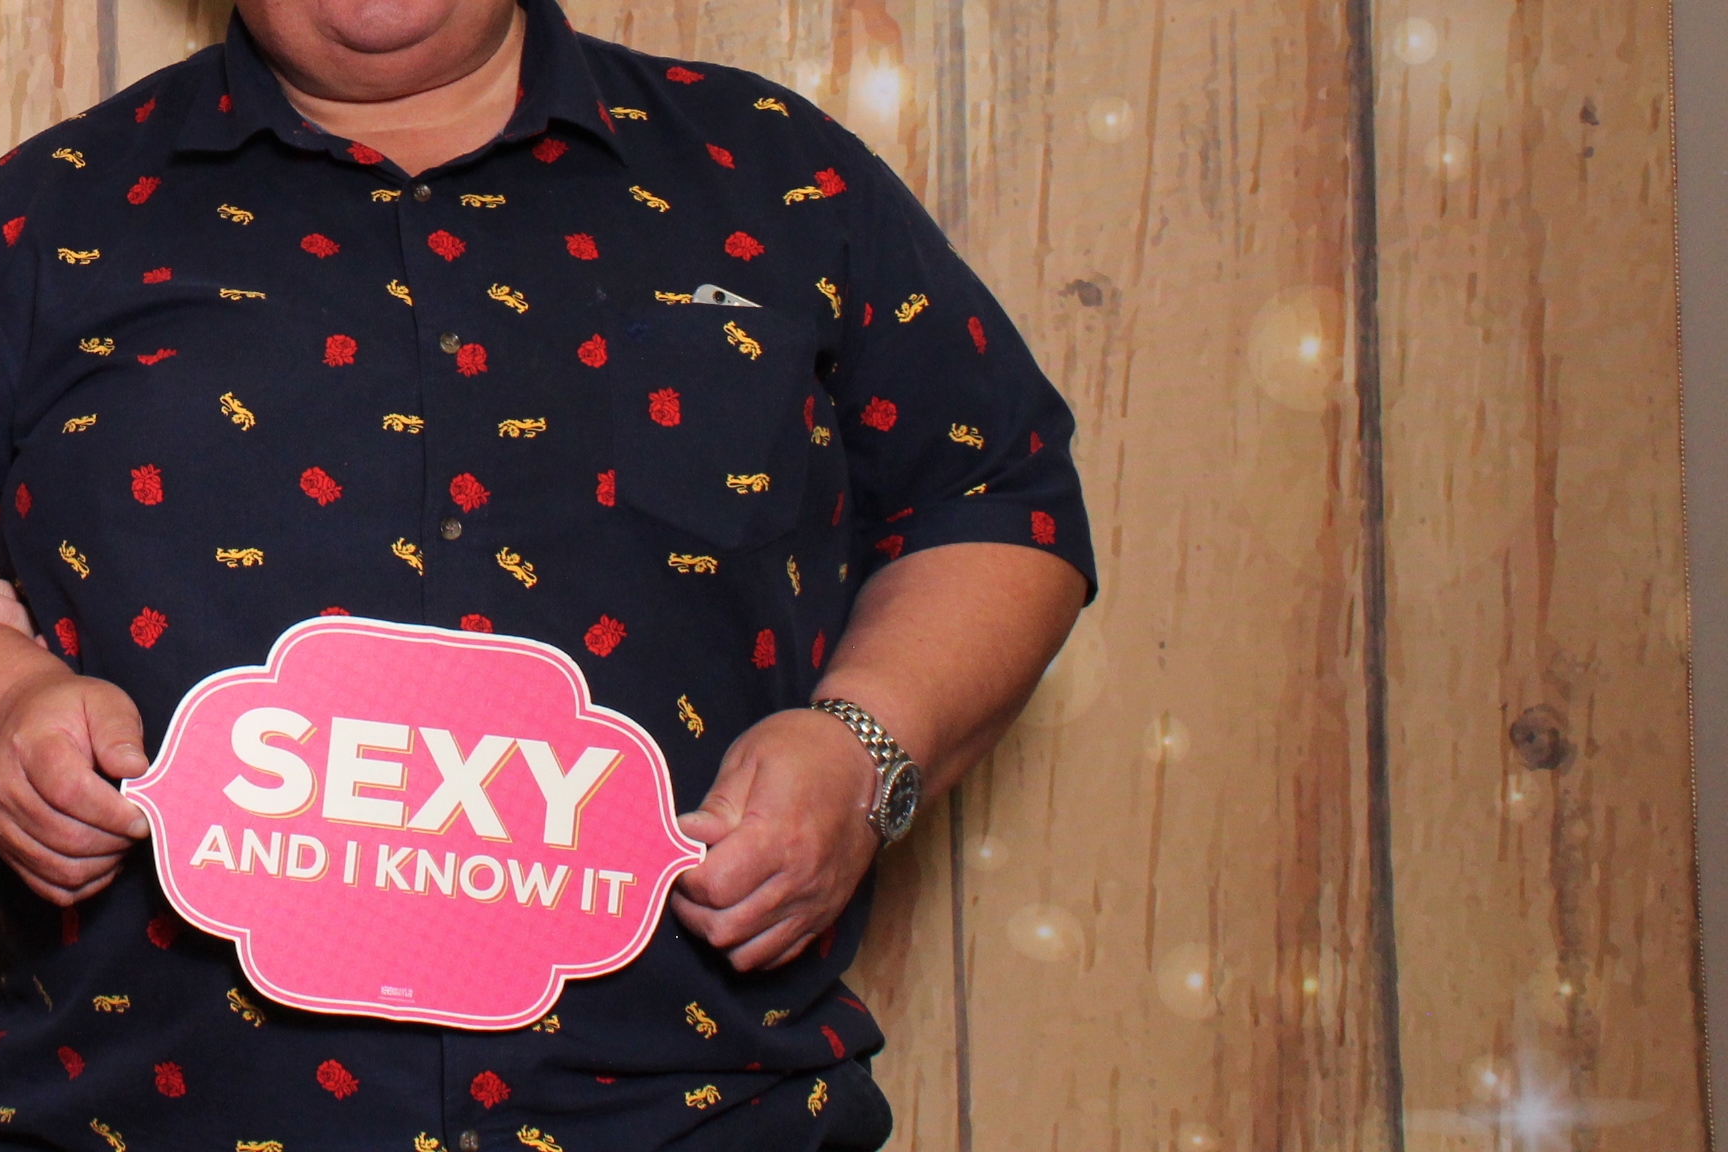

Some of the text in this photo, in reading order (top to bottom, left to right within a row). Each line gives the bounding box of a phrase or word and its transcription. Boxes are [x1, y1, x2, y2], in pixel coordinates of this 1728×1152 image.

[222, 706, 624, 850] SEXY
[189, 824, 637, 918] AND I KNOW IT
